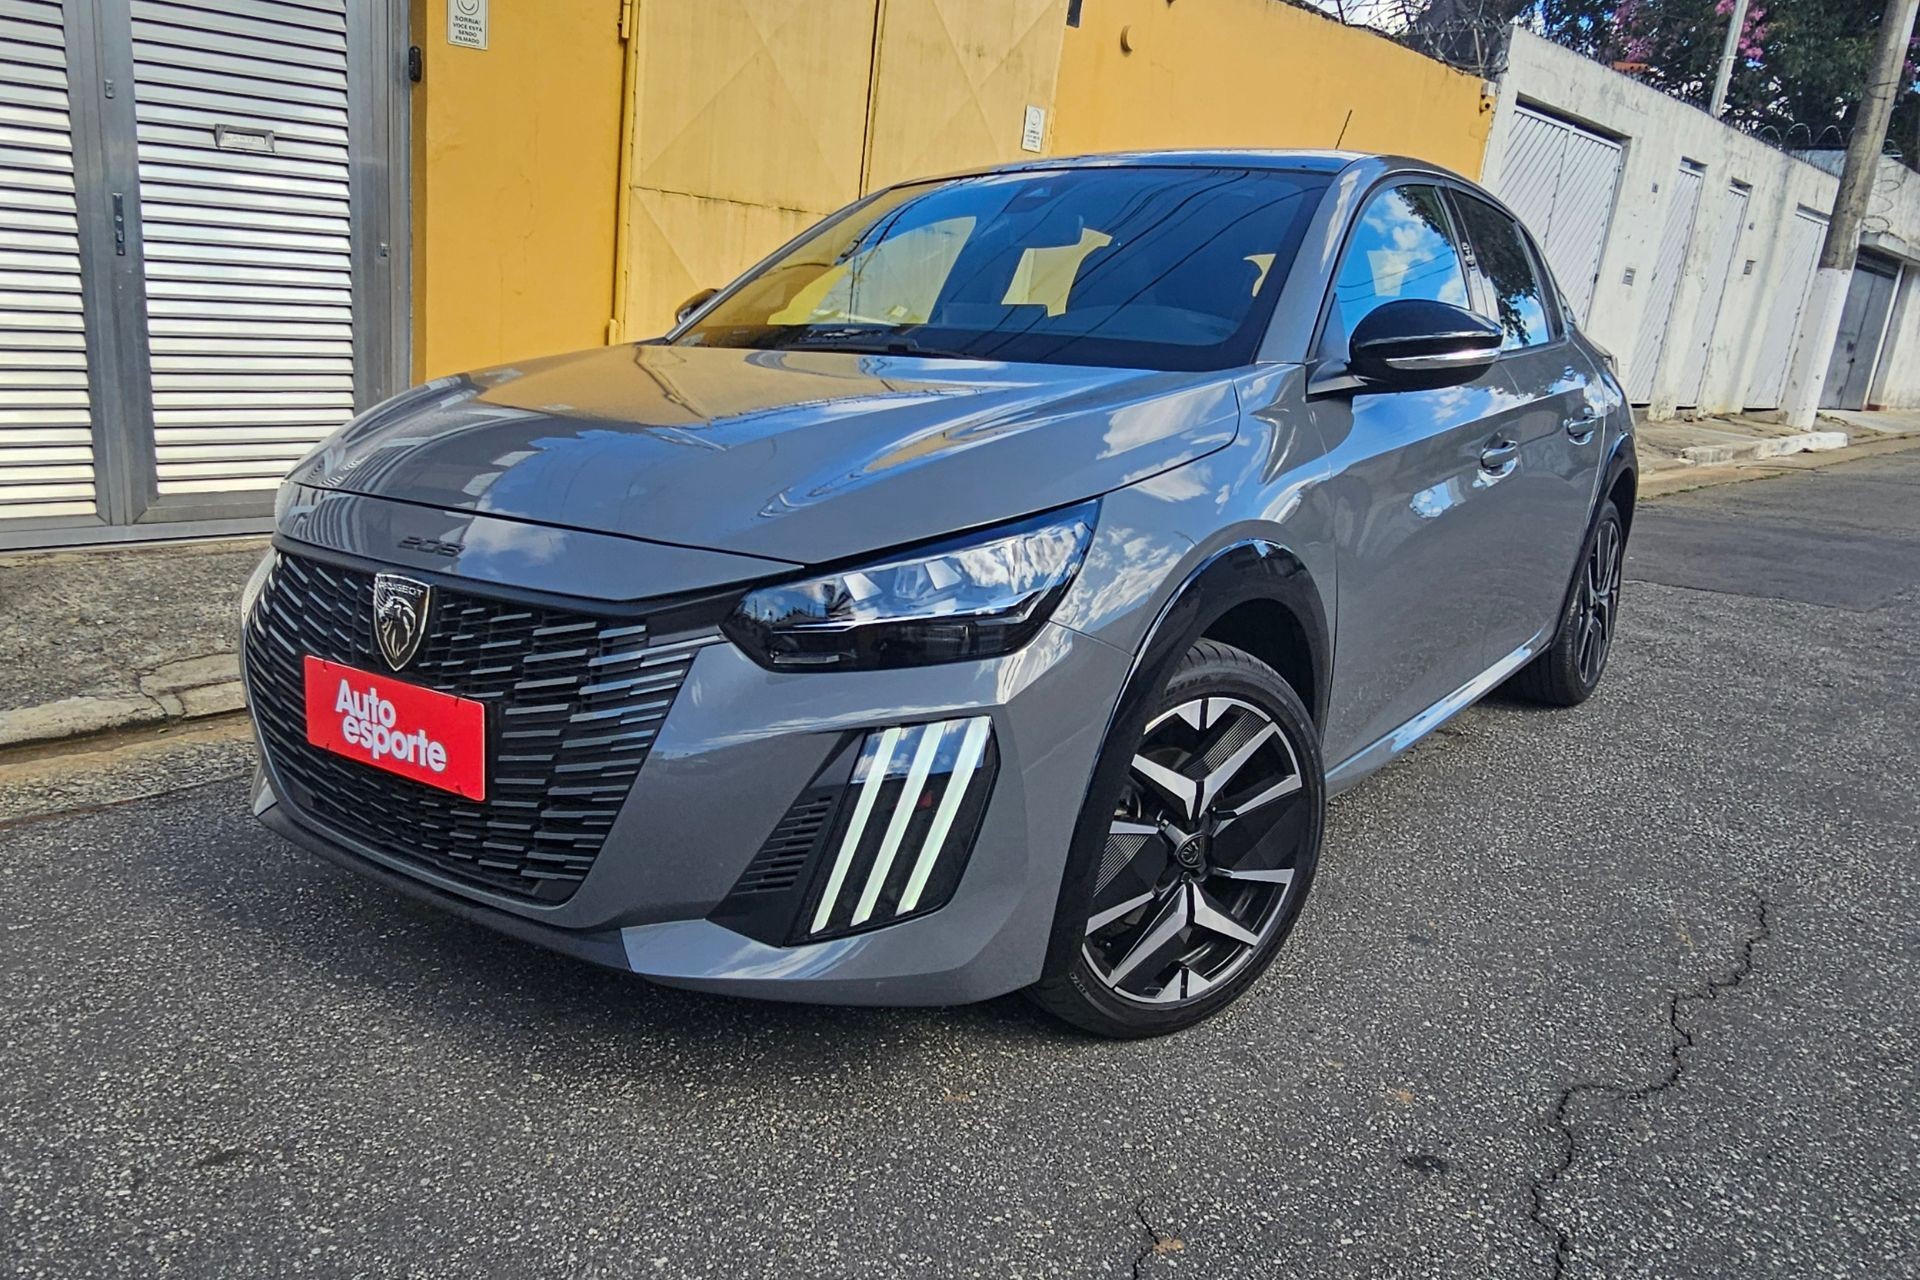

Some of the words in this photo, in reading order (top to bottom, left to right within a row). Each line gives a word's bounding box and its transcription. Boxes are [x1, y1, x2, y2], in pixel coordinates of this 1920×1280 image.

[455, 35, 480, 44] FILMADO
[458, 29, 477, 37] SENDO
[335, 679, 396, 728] Auto
[342, 715, 447, 772] esporte
